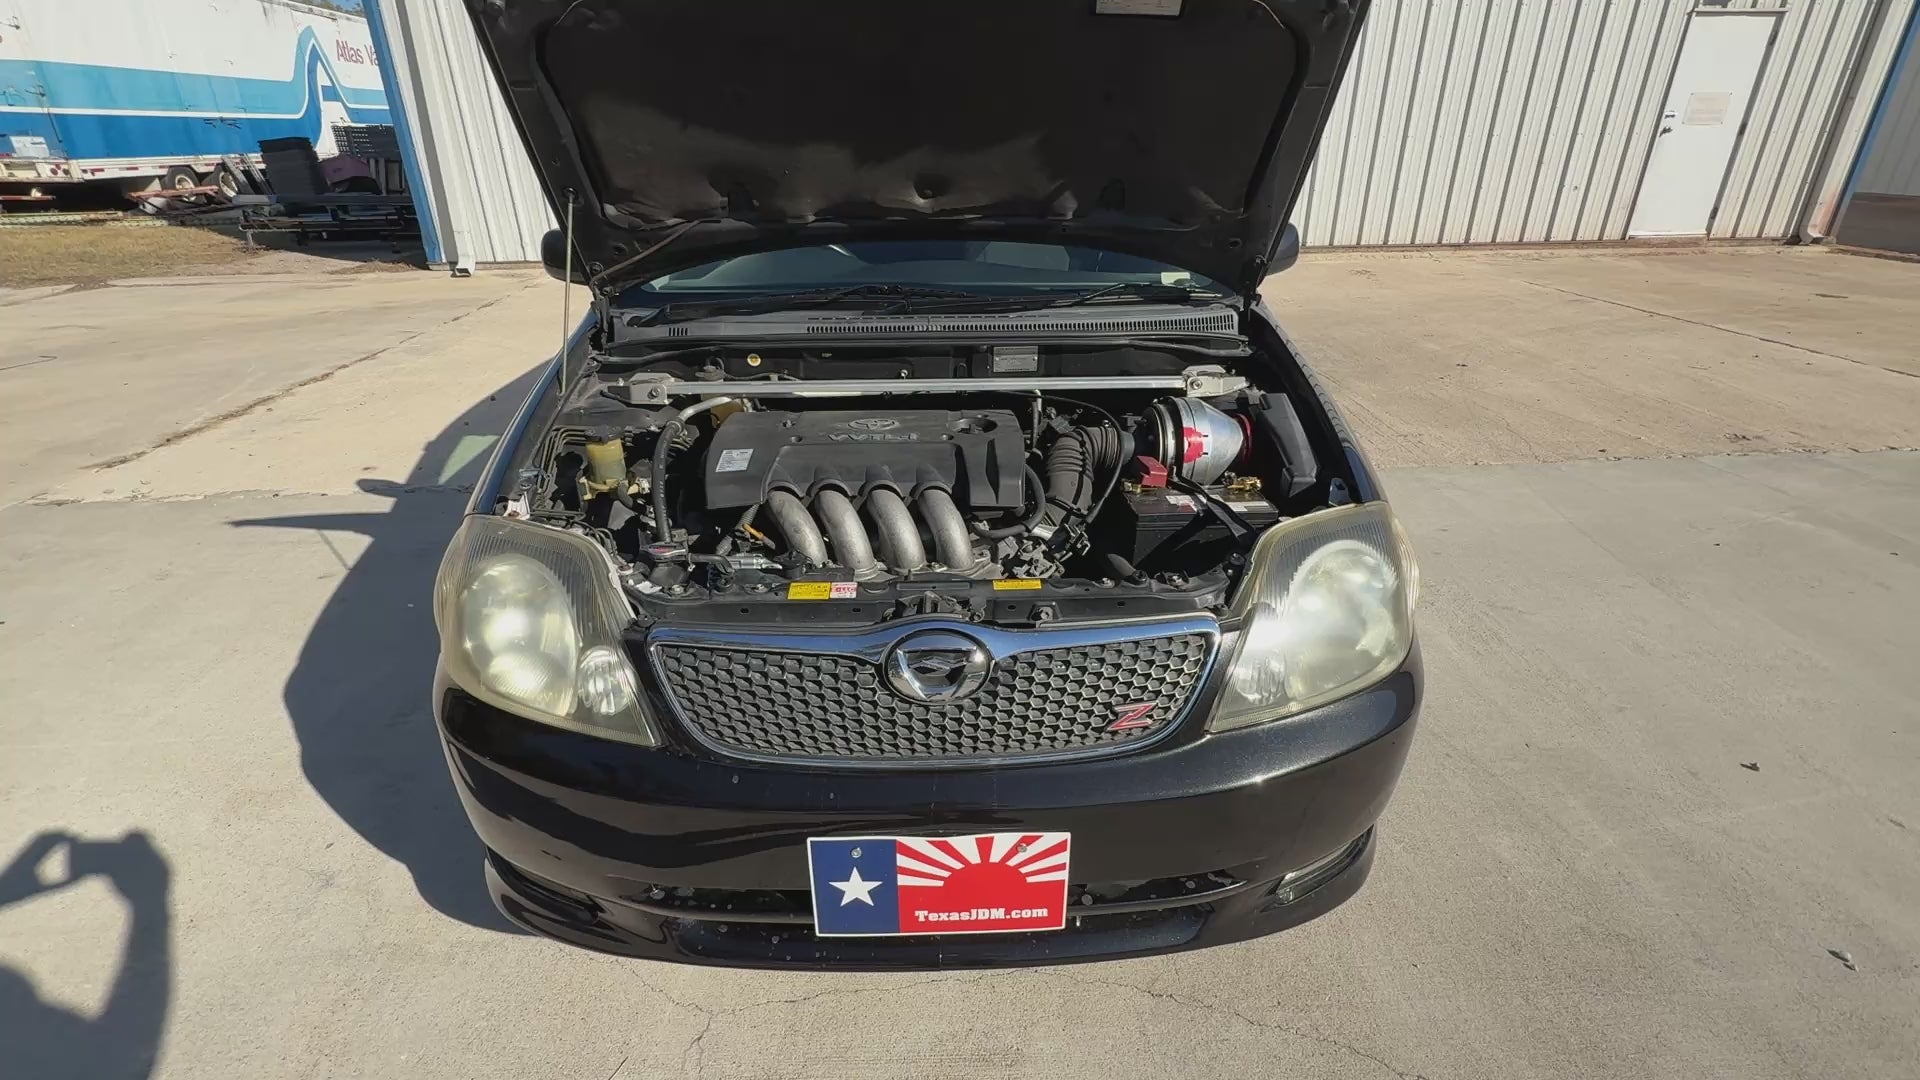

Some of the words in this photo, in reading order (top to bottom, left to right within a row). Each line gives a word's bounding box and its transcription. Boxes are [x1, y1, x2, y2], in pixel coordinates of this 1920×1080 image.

[336, 39, 364, 65] Atlas
[1107, 702, 1157, 731] Z
[914, 906, 1049, 922] TexasJDM.com
